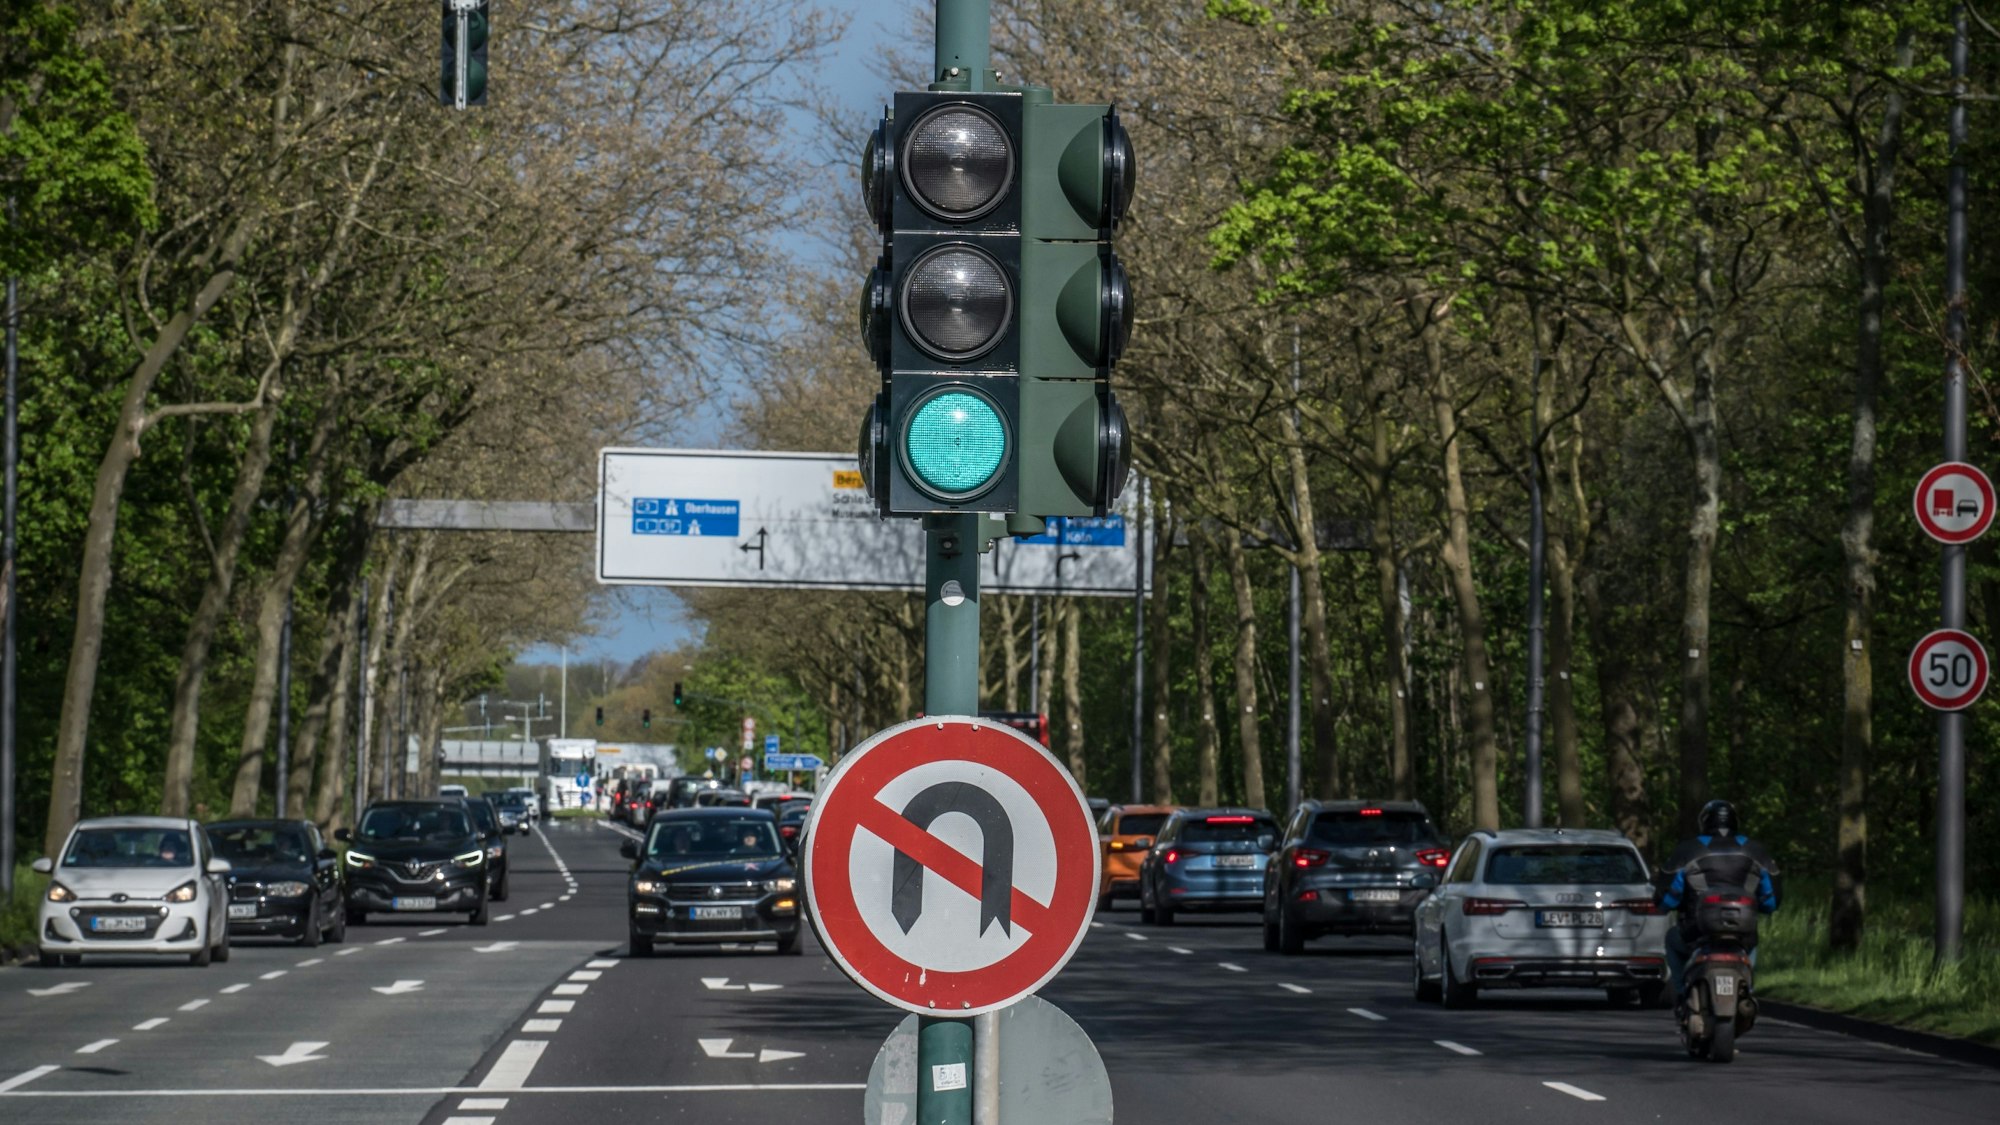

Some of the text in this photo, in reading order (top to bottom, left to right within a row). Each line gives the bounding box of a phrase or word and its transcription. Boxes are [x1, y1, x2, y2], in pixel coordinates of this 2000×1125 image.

[685, 502, 737, 514] Oberhausen
[1929, 653, 1972, 687] 50
[1543, 912, 1565, 924] LEV
[1572, 912, 1585, 924] PL
